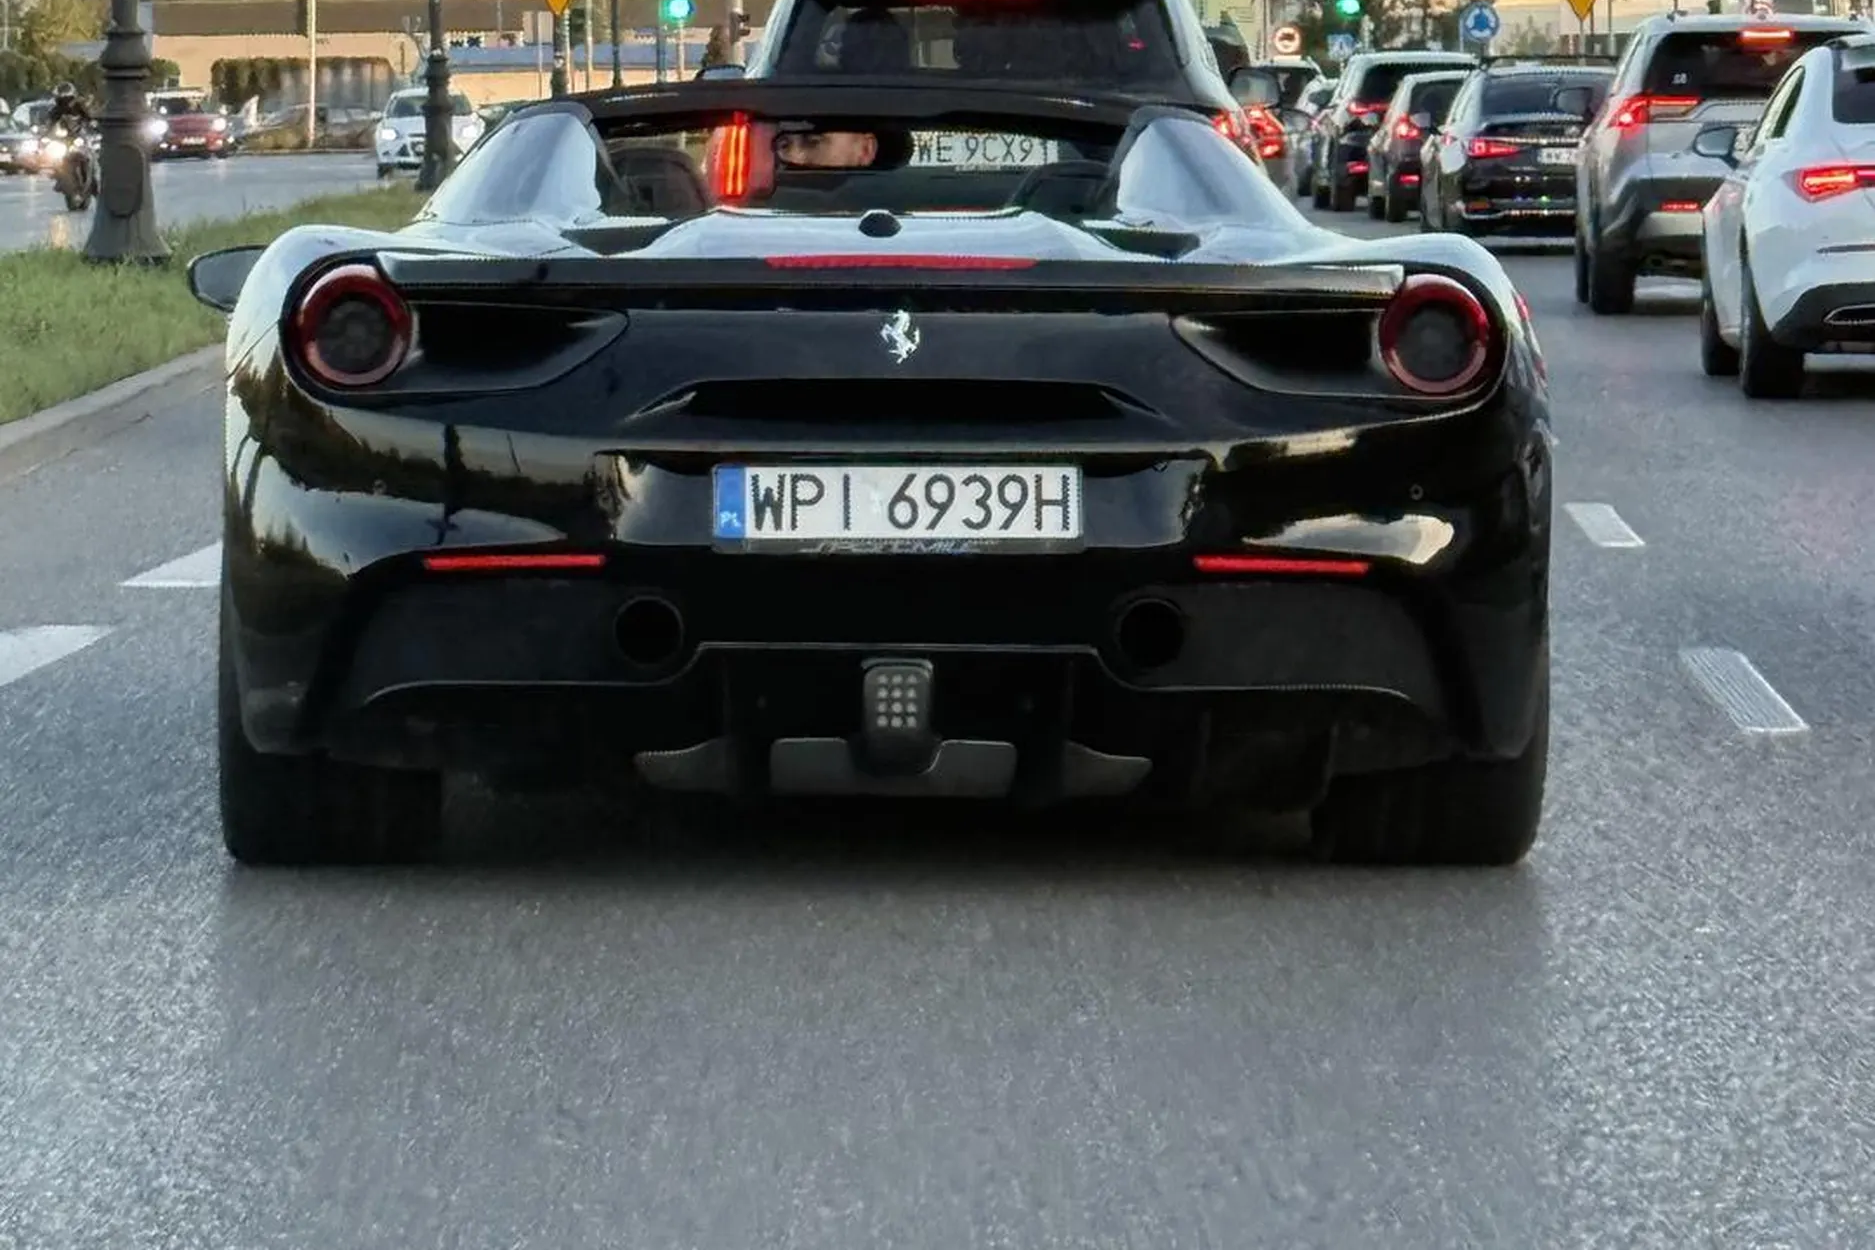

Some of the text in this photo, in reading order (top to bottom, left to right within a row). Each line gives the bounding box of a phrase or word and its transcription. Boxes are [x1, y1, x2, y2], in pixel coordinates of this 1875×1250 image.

[720, 511, 741, 528] PL
[750, 472, 1070, 531] WPI 6939H
